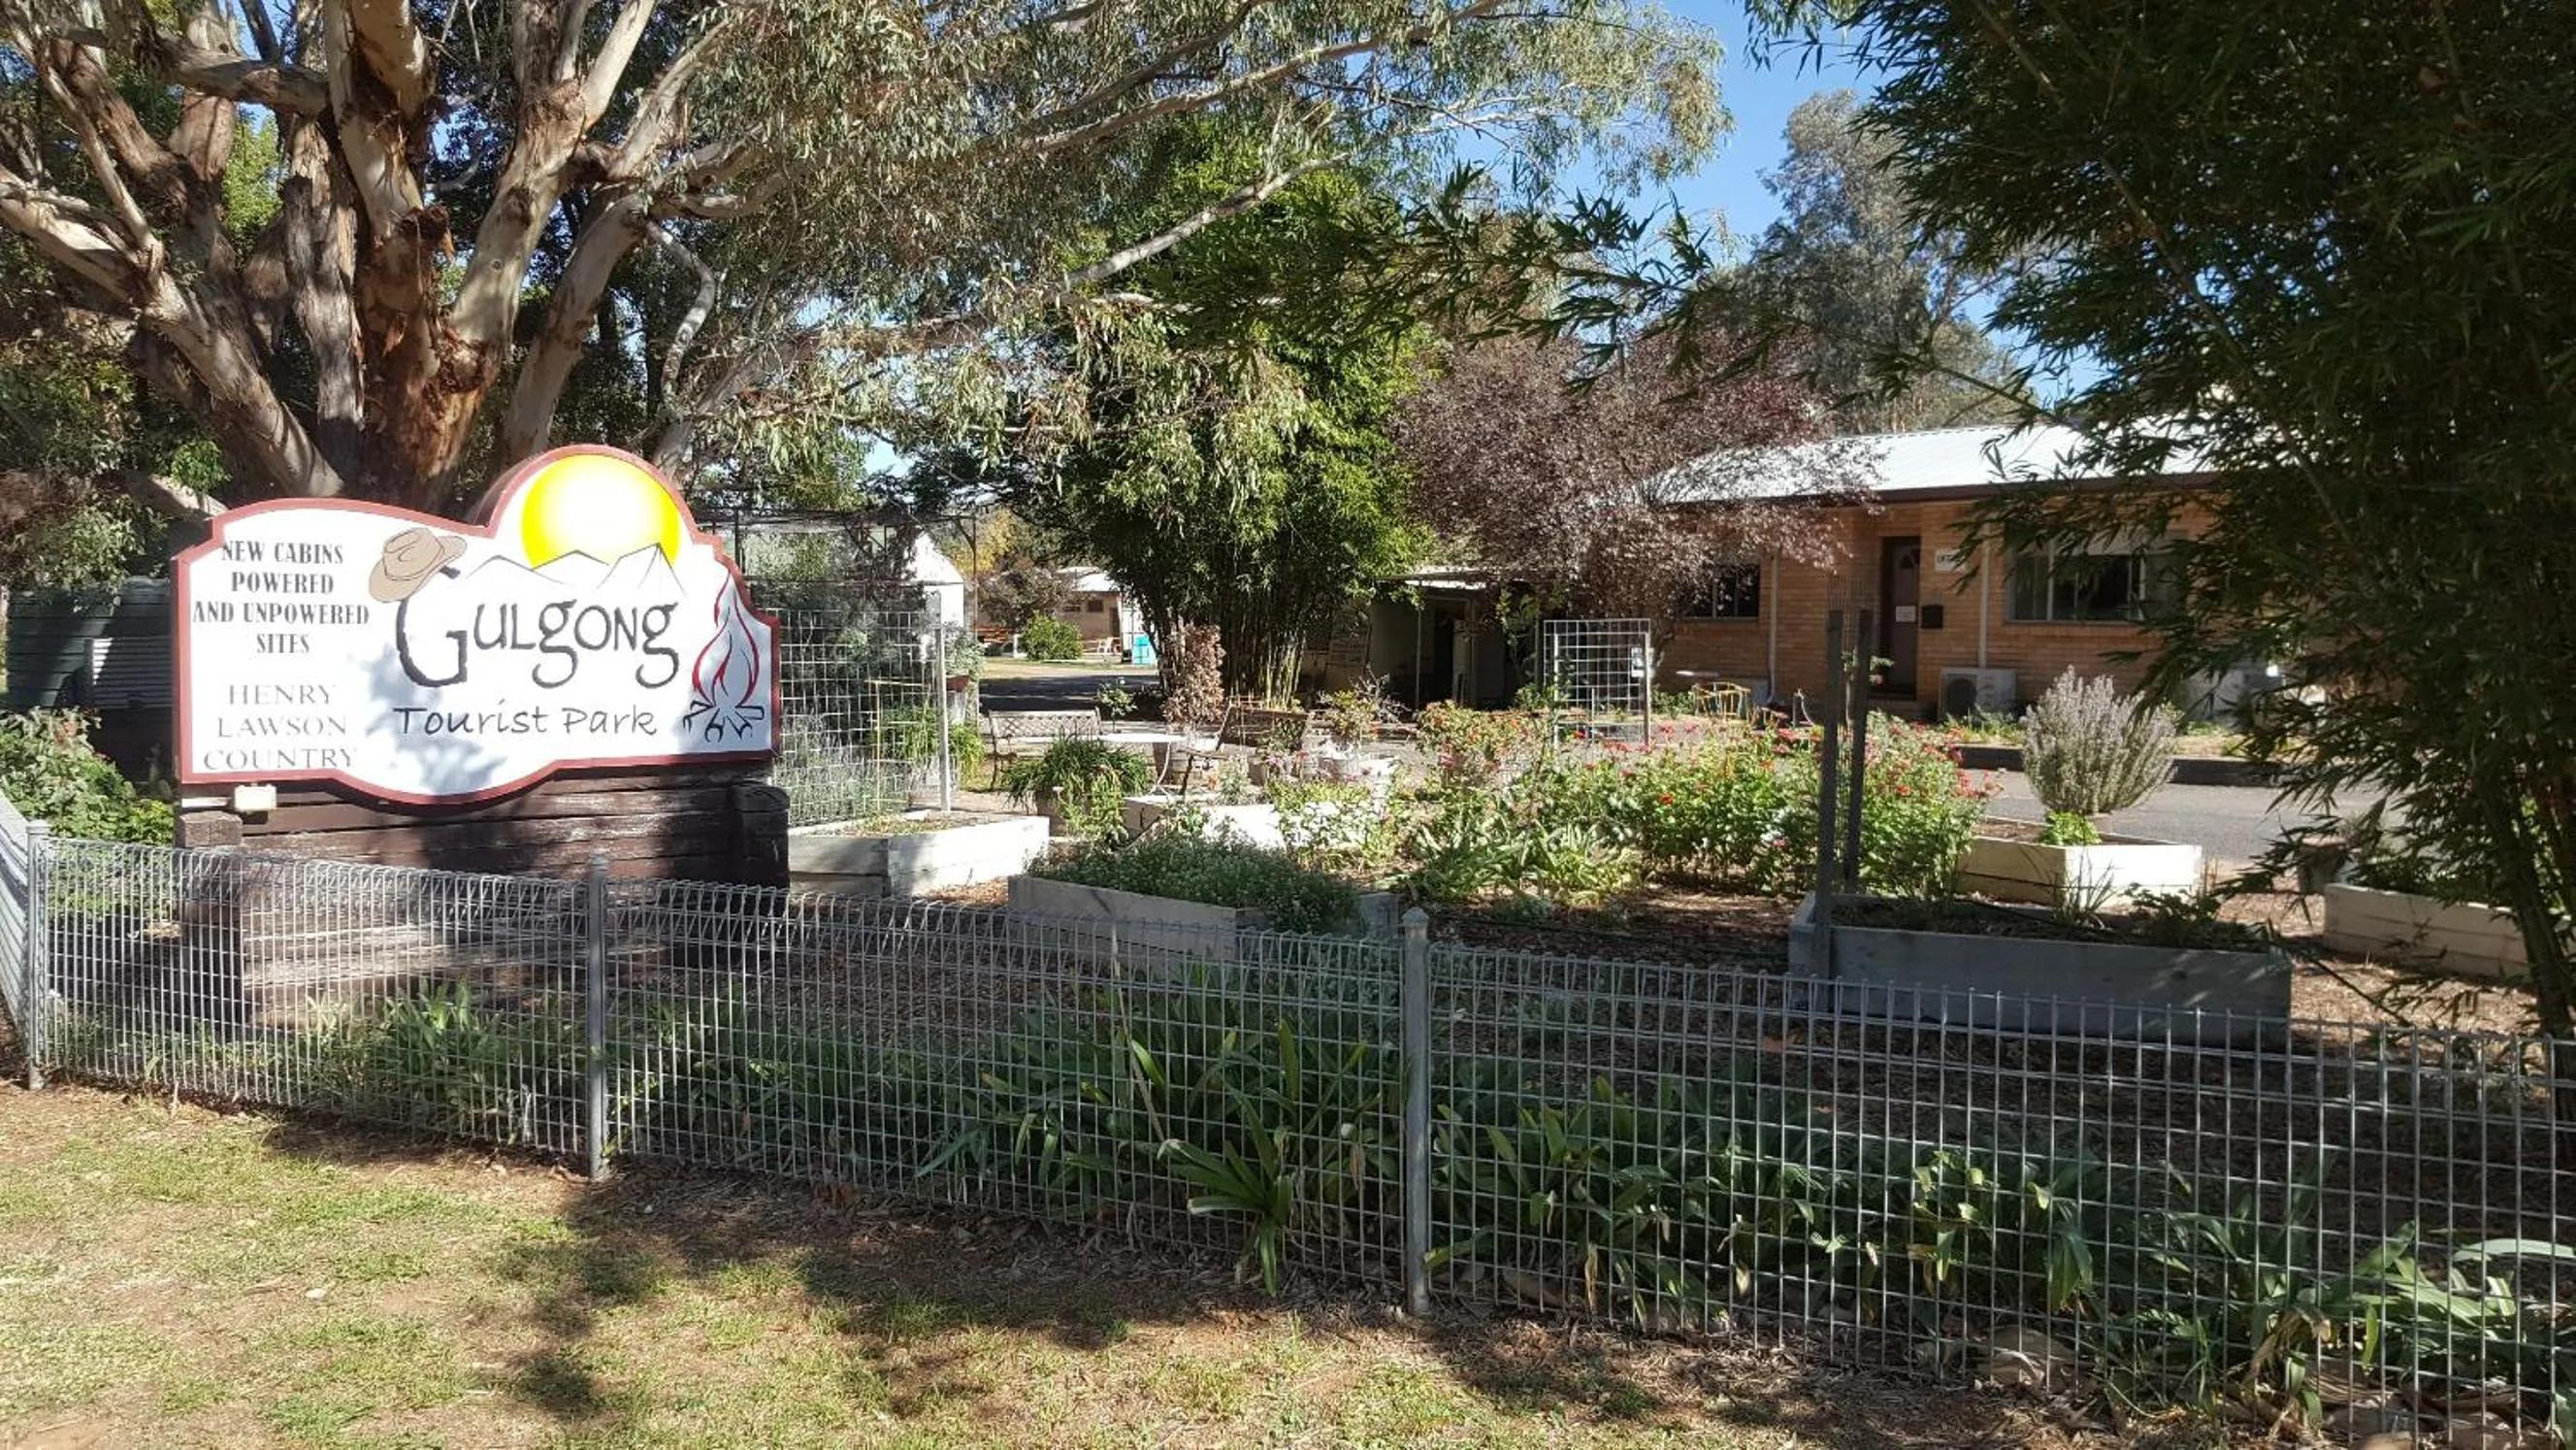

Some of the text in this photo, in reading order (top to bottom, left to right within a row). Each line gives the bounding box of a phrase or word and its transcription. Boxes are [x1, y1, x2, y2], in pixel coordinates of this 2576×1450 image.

[221, 540, 343, 564] NEW CABINS
[231, 571, 335, 595] POWERED
[193, 600, 371, 625] AND UNPOWERED
[256, 633, 310, 654] SITES
[229, 683, 337, 706] HENRY
[217, 715, 347, 739] LAWSON
[392, 698, 658, 737] Tourist Park
[203, 747, 357, 771] COUNTRY
